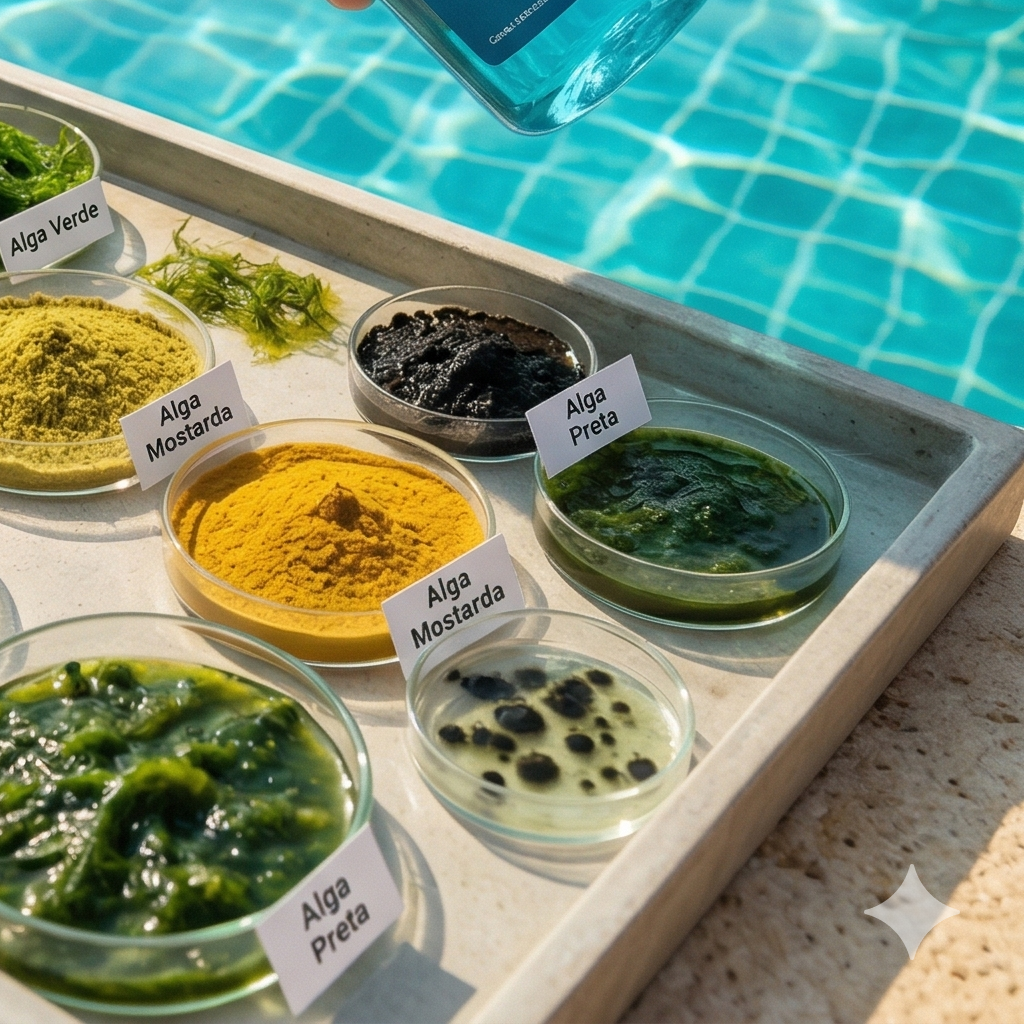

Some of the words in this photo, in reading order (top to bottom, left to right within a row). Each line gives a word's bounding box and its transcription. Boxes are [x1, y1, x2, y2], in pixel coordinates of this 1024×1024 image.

[11, 228, 48, 257] Alga
[48, 202, 99, 236] Verde
[160, 394, 202, 427] Alga
[567, 387, 607, 420] Alga
[568, 410, 620, 447] Preta
[145, 405, 234, 463] Mostarda
[428, 572, 472, 609] Alga
[410, 585, 506, 650] Mostarda
[302, 878, 351, 930] Alga
[311, 904, 370, 964] Preta
